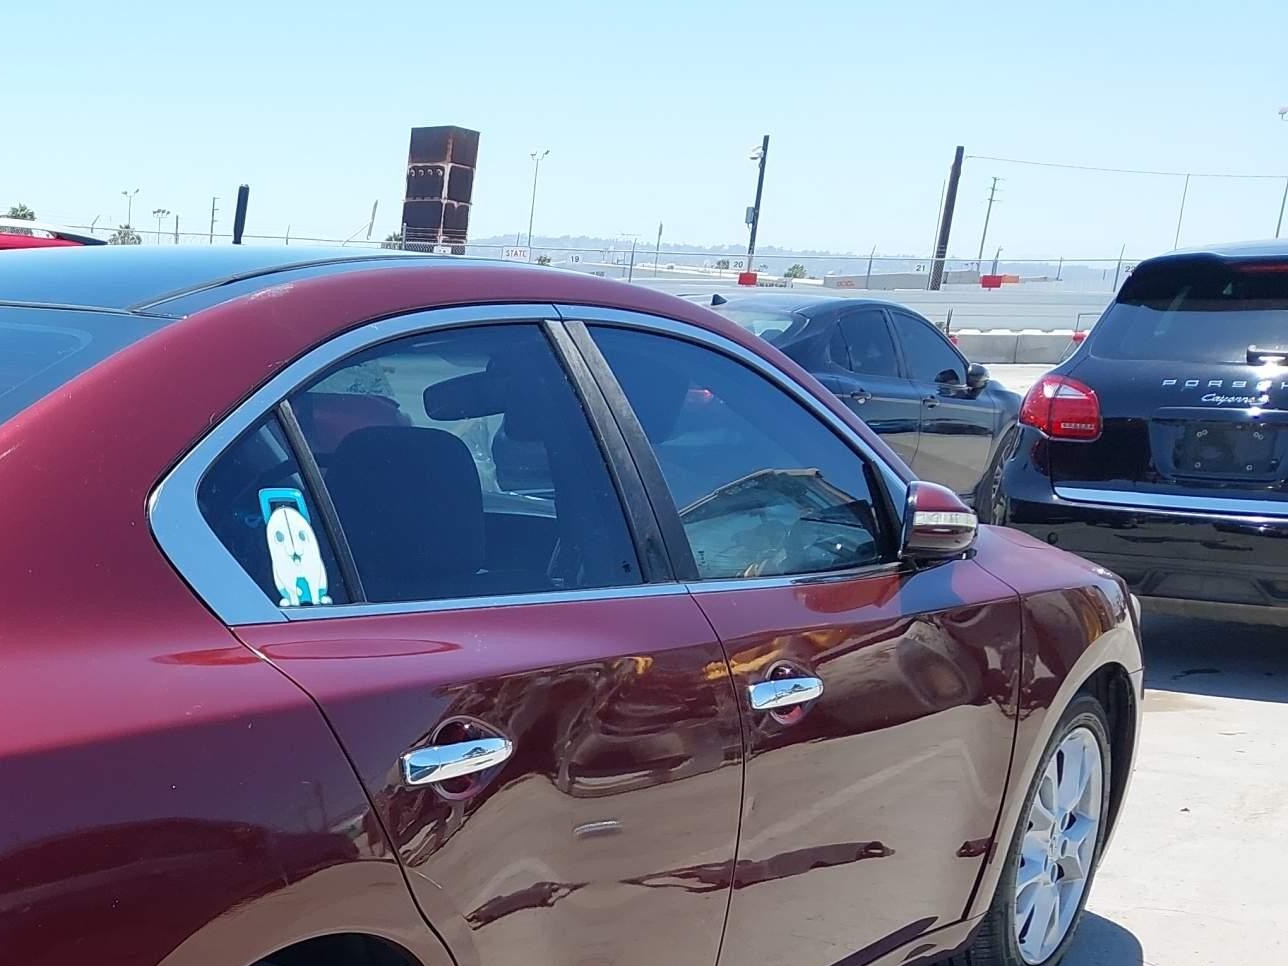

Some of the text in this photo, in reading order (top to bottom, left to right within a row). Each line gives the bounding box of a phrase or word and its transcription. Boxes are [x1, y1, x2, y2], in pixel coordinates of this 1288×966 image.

[570, 255, 580, 263] 19
[732, 260, 744, 269] 20
[915, 264, 926, 272] 21
